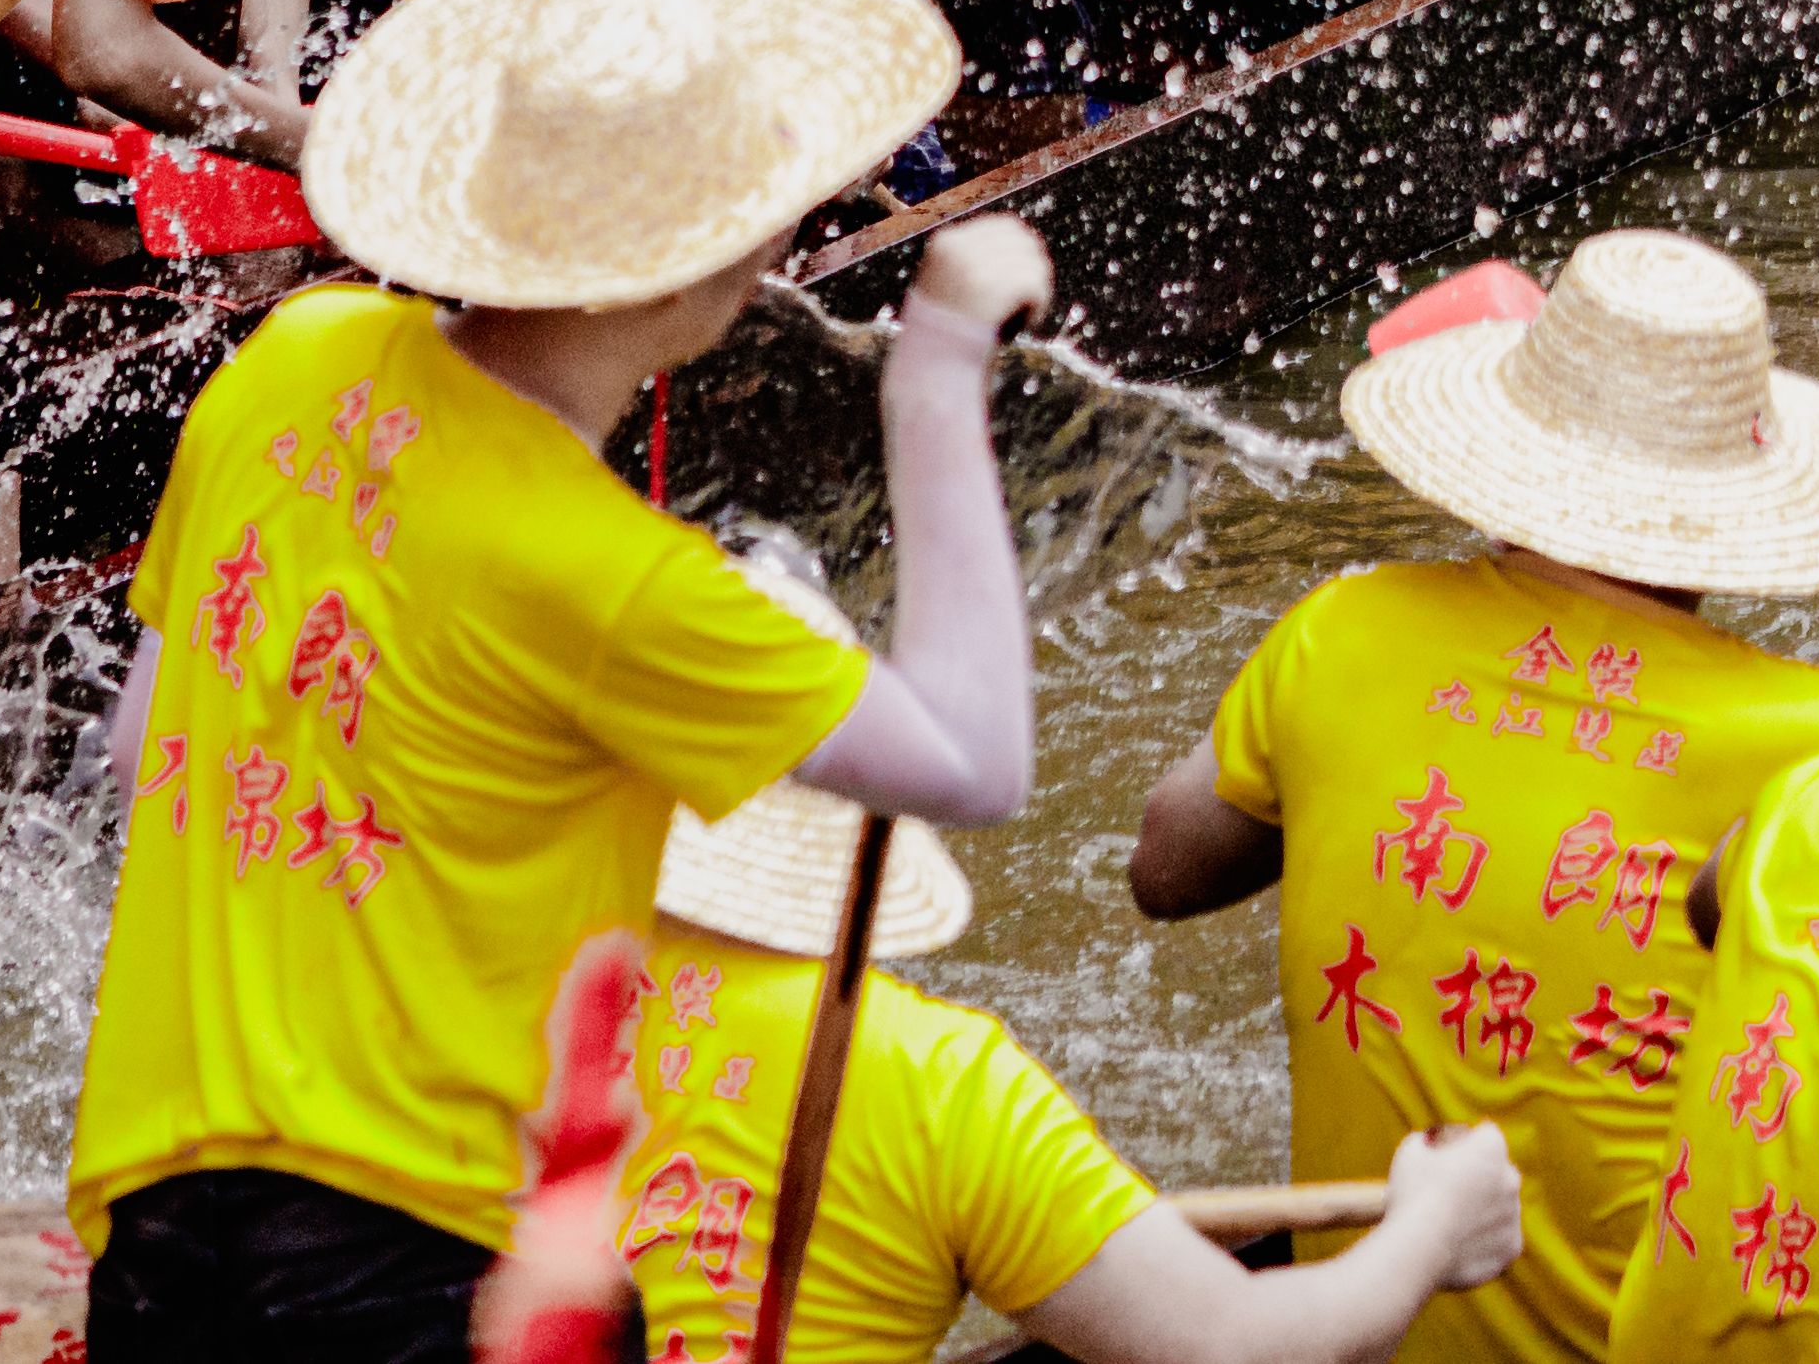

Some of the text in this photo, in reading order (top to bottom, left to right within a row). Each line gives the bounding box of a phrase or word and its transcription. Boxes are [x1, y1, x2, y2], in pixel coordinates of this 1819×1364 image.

[192, 522, 380, 750] 南朗
[1506, 623, 1643, 705] 金裝
[1372, 765, 1679, 953] 南朗
[1315, 923, 1692, 1091] 木棉坊
